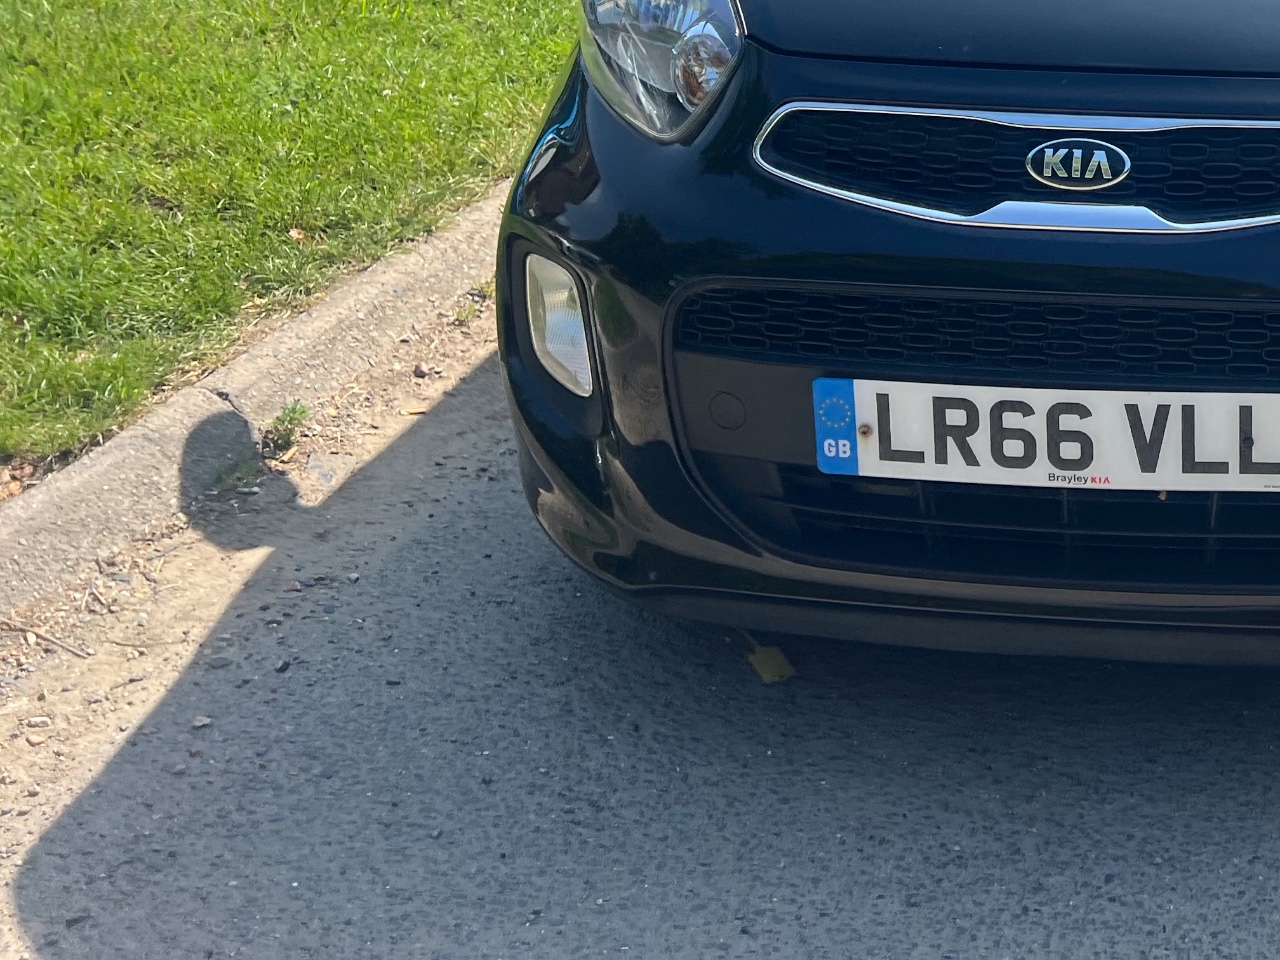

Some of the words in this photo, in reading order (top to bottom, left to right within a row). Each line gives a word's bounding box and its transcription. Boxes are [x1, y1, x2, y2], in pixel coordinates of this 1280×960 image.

[1043, 148, 1112, 179] KIA
[875, 392, 1094, 471] LR66
[823, 438, 851, 458] GB
[1047, 472, 1089, 485] Brayley
[1090, 476, 1110, 484] KIA
